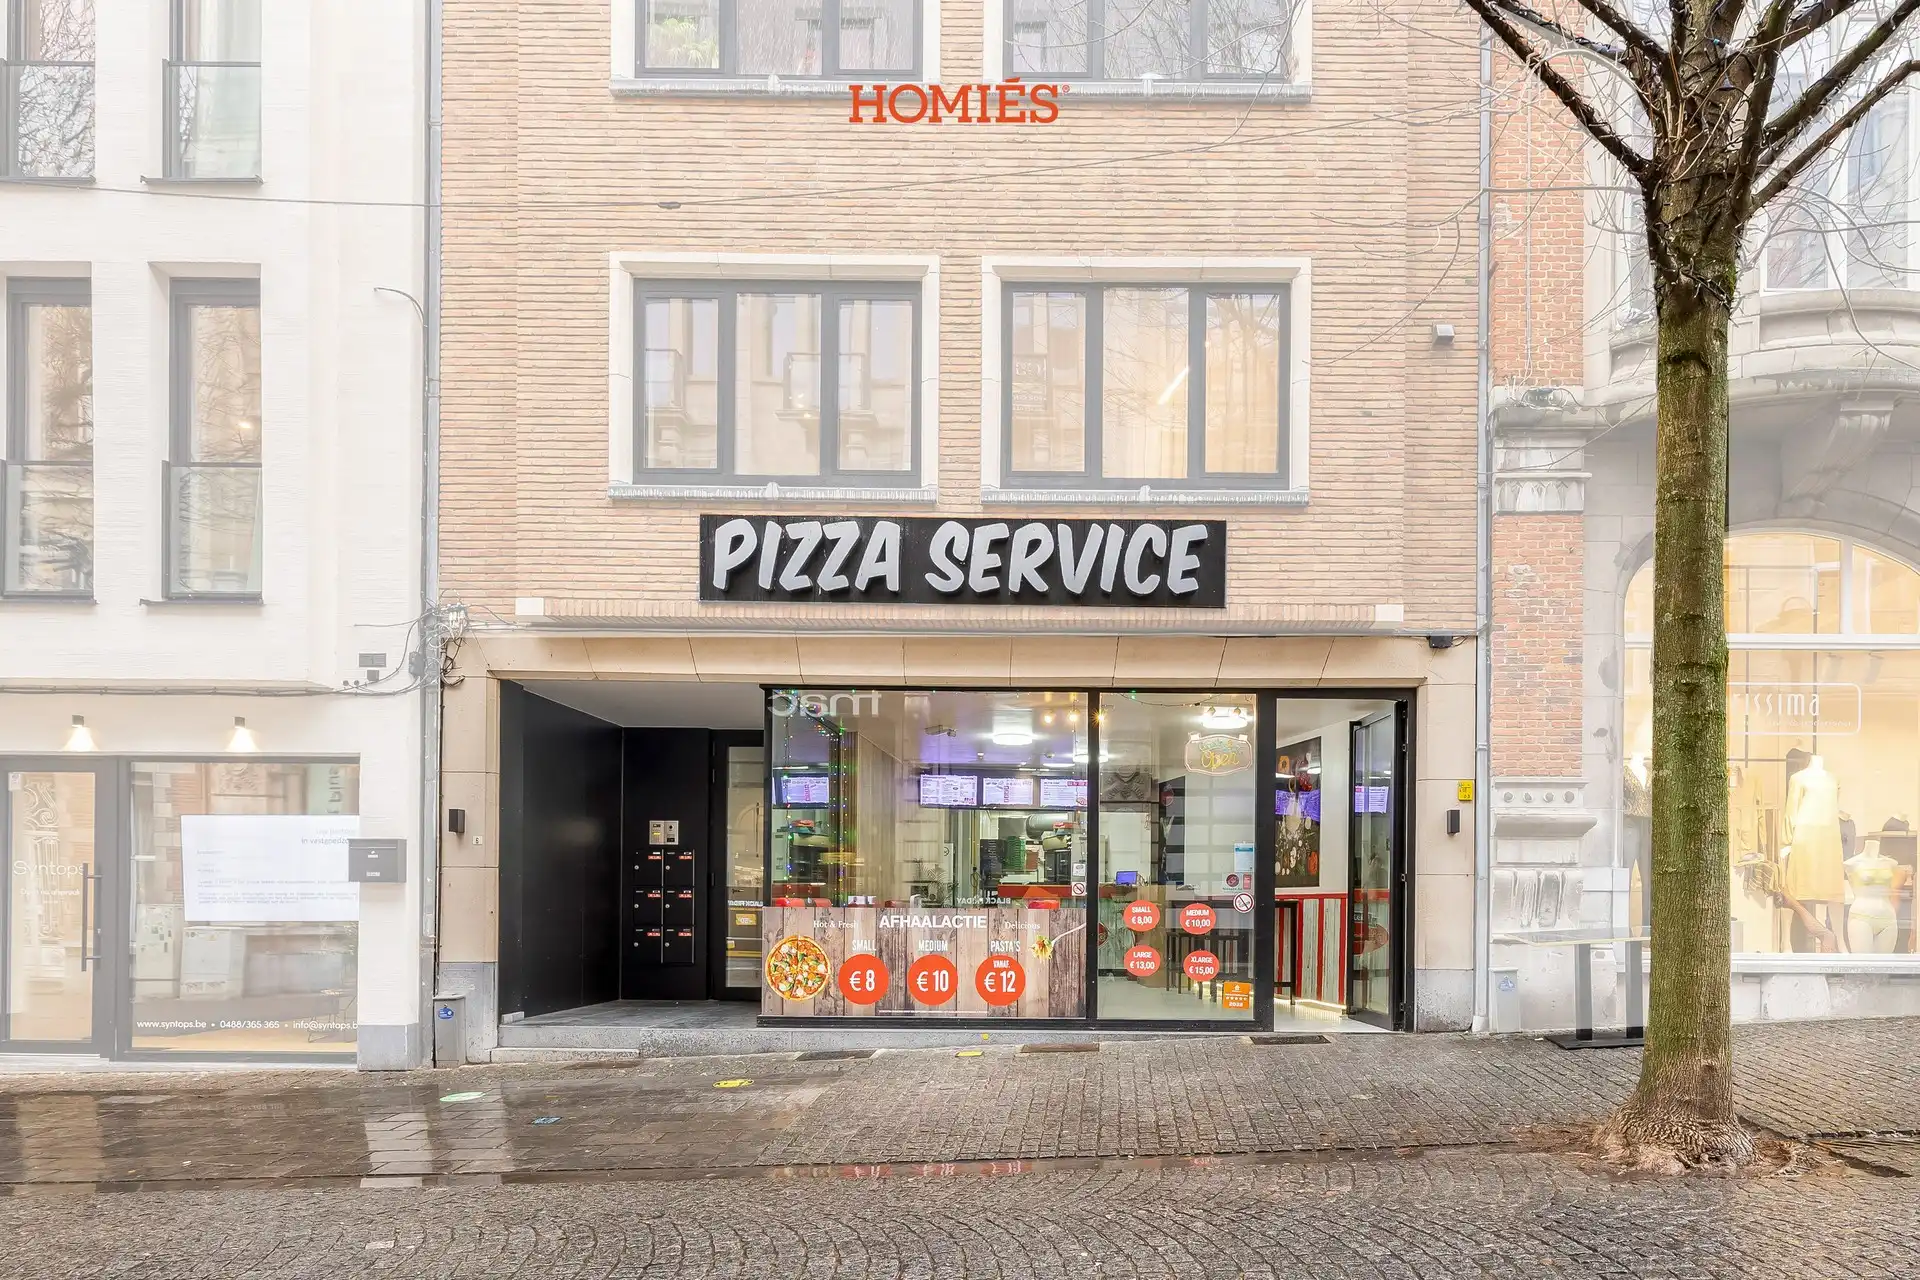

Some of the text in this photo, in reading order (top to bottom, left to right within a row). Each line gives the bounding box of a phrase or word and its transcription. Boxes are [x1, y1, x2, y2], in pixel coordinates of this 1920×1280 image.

[712, 518, 1208, 595] PIZZA SERVICE
[1131, 906, 1152, 914] SMALL
[1185, 909, 1209, 917] MEDIUM
[813, 920, 859, 929] Hot & Fresh
[879, 914, 988, 929] AFHAALACTIE
[1004, 921, 1041, 930] Delicious
[1131, 915, 1153, 926] € 8,00
[1185, 919, 1211, 929] € 10,00
[852, 939, 877, 951] SMALL
[918, 939, 949, 952] MEDIUM
[990, 940, 1021, 952] PASTA'S
[1133, 951, 1153, 959] LARGE
[1129, 960, 1155, 970] € 13,00
[1188, 965, 1214, 976] € 15,00
[849, 969, 876, 992] € 8
[916, 969, 949, 992] € 10
[984, 970, 1016, 993] € 12
[136, 1019, 207, 1030] www.syntops.be
[219, 1020, 262, 1030] 0488/365
[263, 1020, 280, 1029] 365
